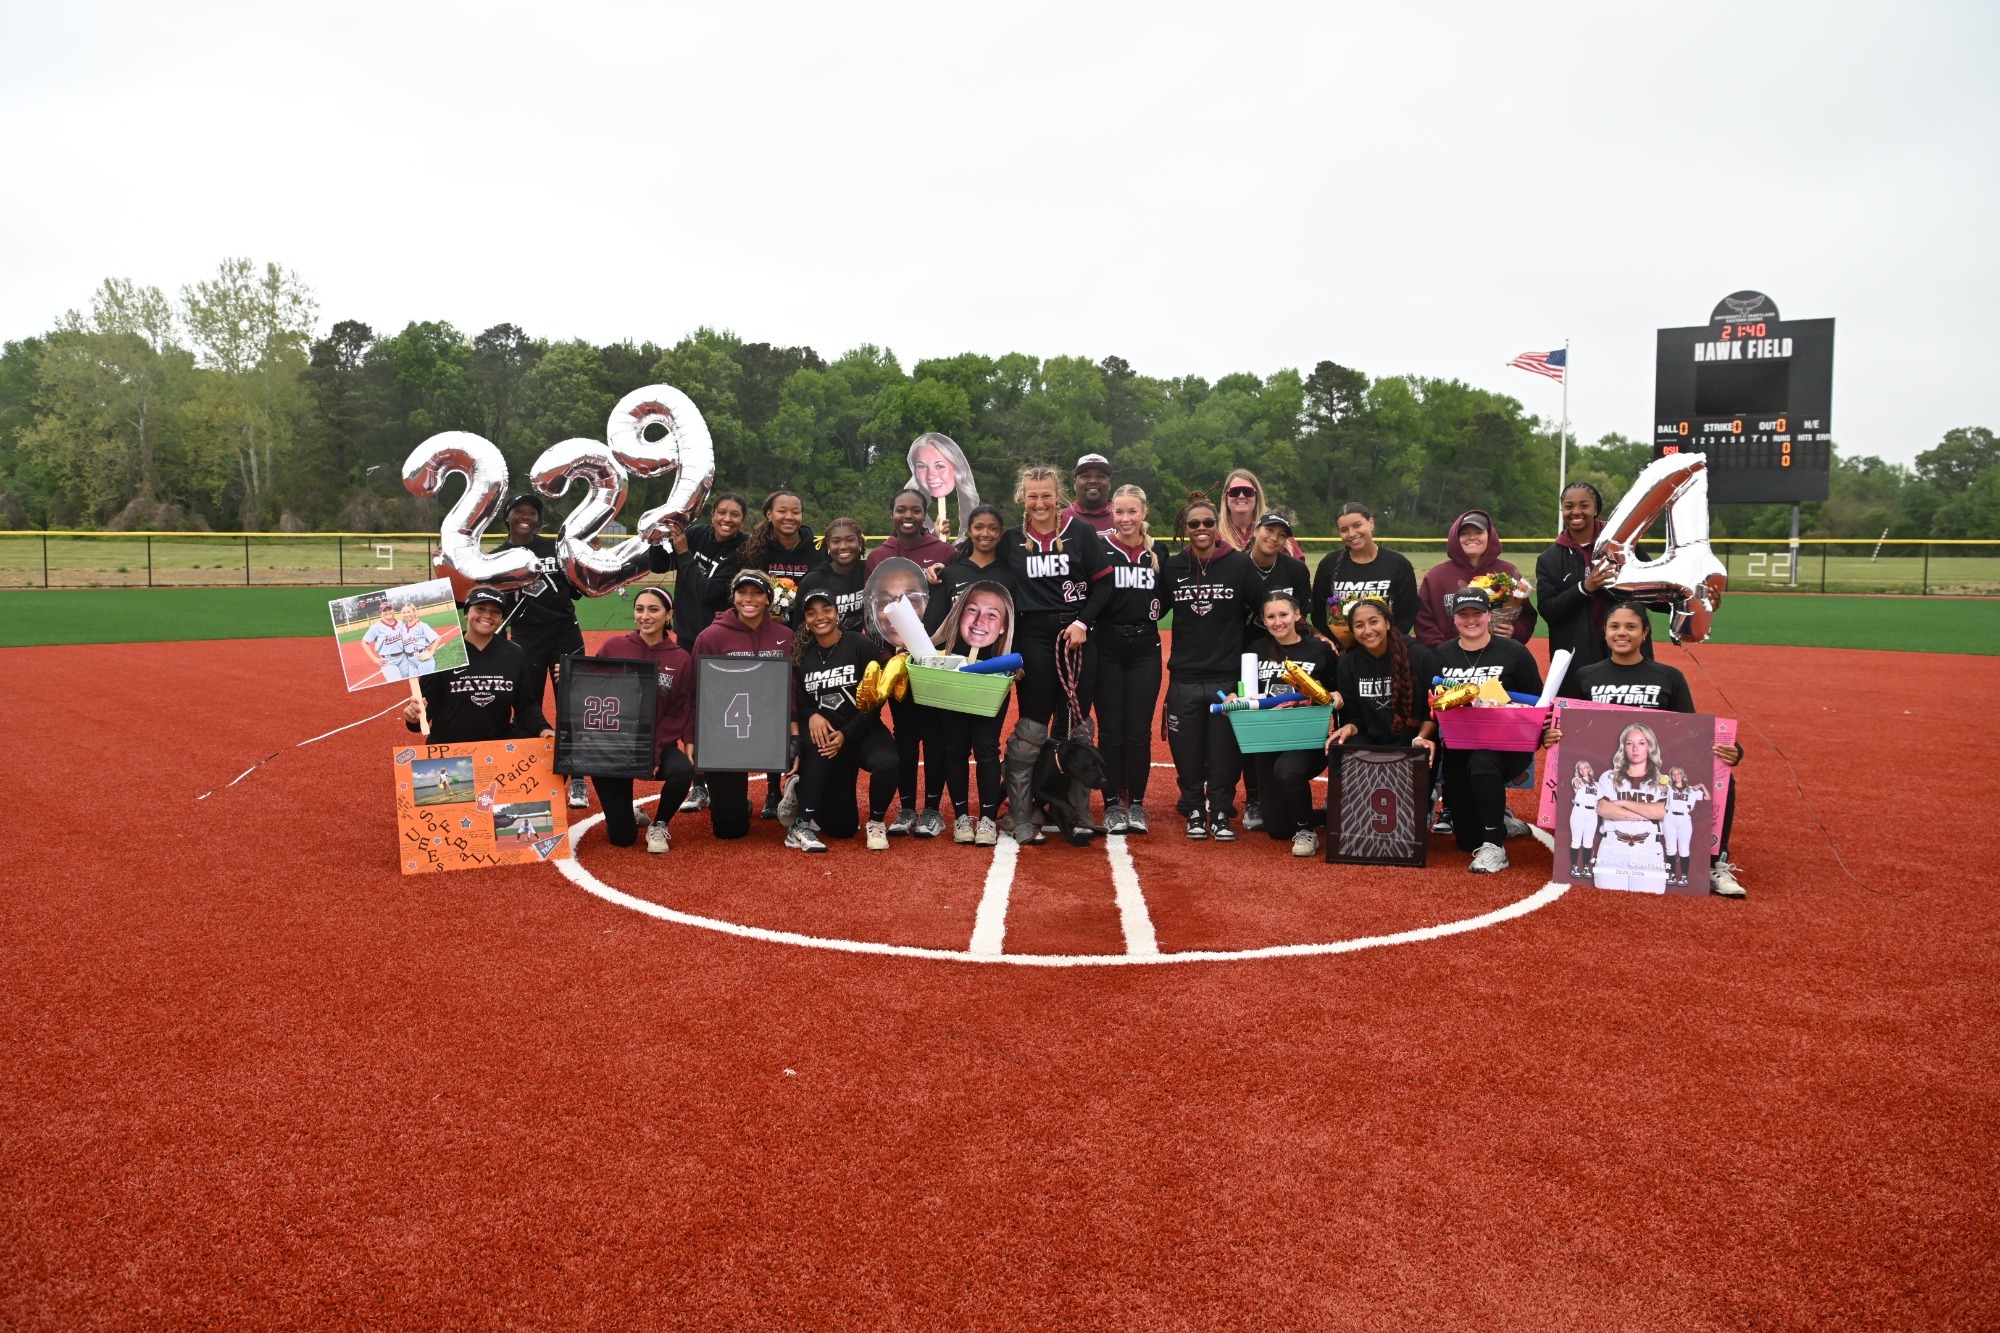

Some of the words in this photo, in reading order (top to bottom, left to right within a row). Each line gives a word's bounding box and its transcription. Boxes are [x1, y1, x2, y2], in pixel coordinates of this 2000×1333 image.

[1694, 341, 1742, 362] HAWK
[1747, 338, 1793, 359] FIELD
[1657, 424, 1678, 434] BALL
[1679, 422, 1688, 435] 0
[1703, 422, 1733, 432] STRIKE
[1732, 420, 1742, 434] 0
[1758, 421, 1777, 431] OUT
[1776, 418, 1786, 432] 0
[1803, 419, 1820, 430] H/E
[1691, 437, 1696, 445] 1
[1709, 436, 1715, 444] 3
[1772, 434, 1791, 442] RUNS
[1797, 433, 1813, 441] HITS
[1782, 442, 1791, 454] 0
[1781, 455, 1790, 467] 0
[376, 545, 393, 570] 9
[1026, 554, 1069, 578] UMES
[1748, 552, 1791, 577] 22
[769, 564, 809, 573] HAWKS
[1114, 566, 1155, 589] UMES
[1062, 580, 1087, 602] 22
[1173, 588, 1234, 601] HAWKS
[1333, 580, 1391, 591] UMES
[1149, 598, 1160, 620] 9
[804, 664, 855, 682] UMES
[1442, 665, 1504, 677] UMES
[450, 680, 514, 693] HAWKS
[805, 674, 857, 692] SOFTBALL
[1591, 684, 1661, 695] UMES
[584, 695, 620, 731] 22
[724, 693, 751, 738] 4
[427, 745, 450, 759] PP
[494, 754, 537, 788] PaiGe
[519, 776, 540, 795] 22
[1371, 788, 1397, 834] 9
[1630, 860, 1672, 870] GUNTHER
